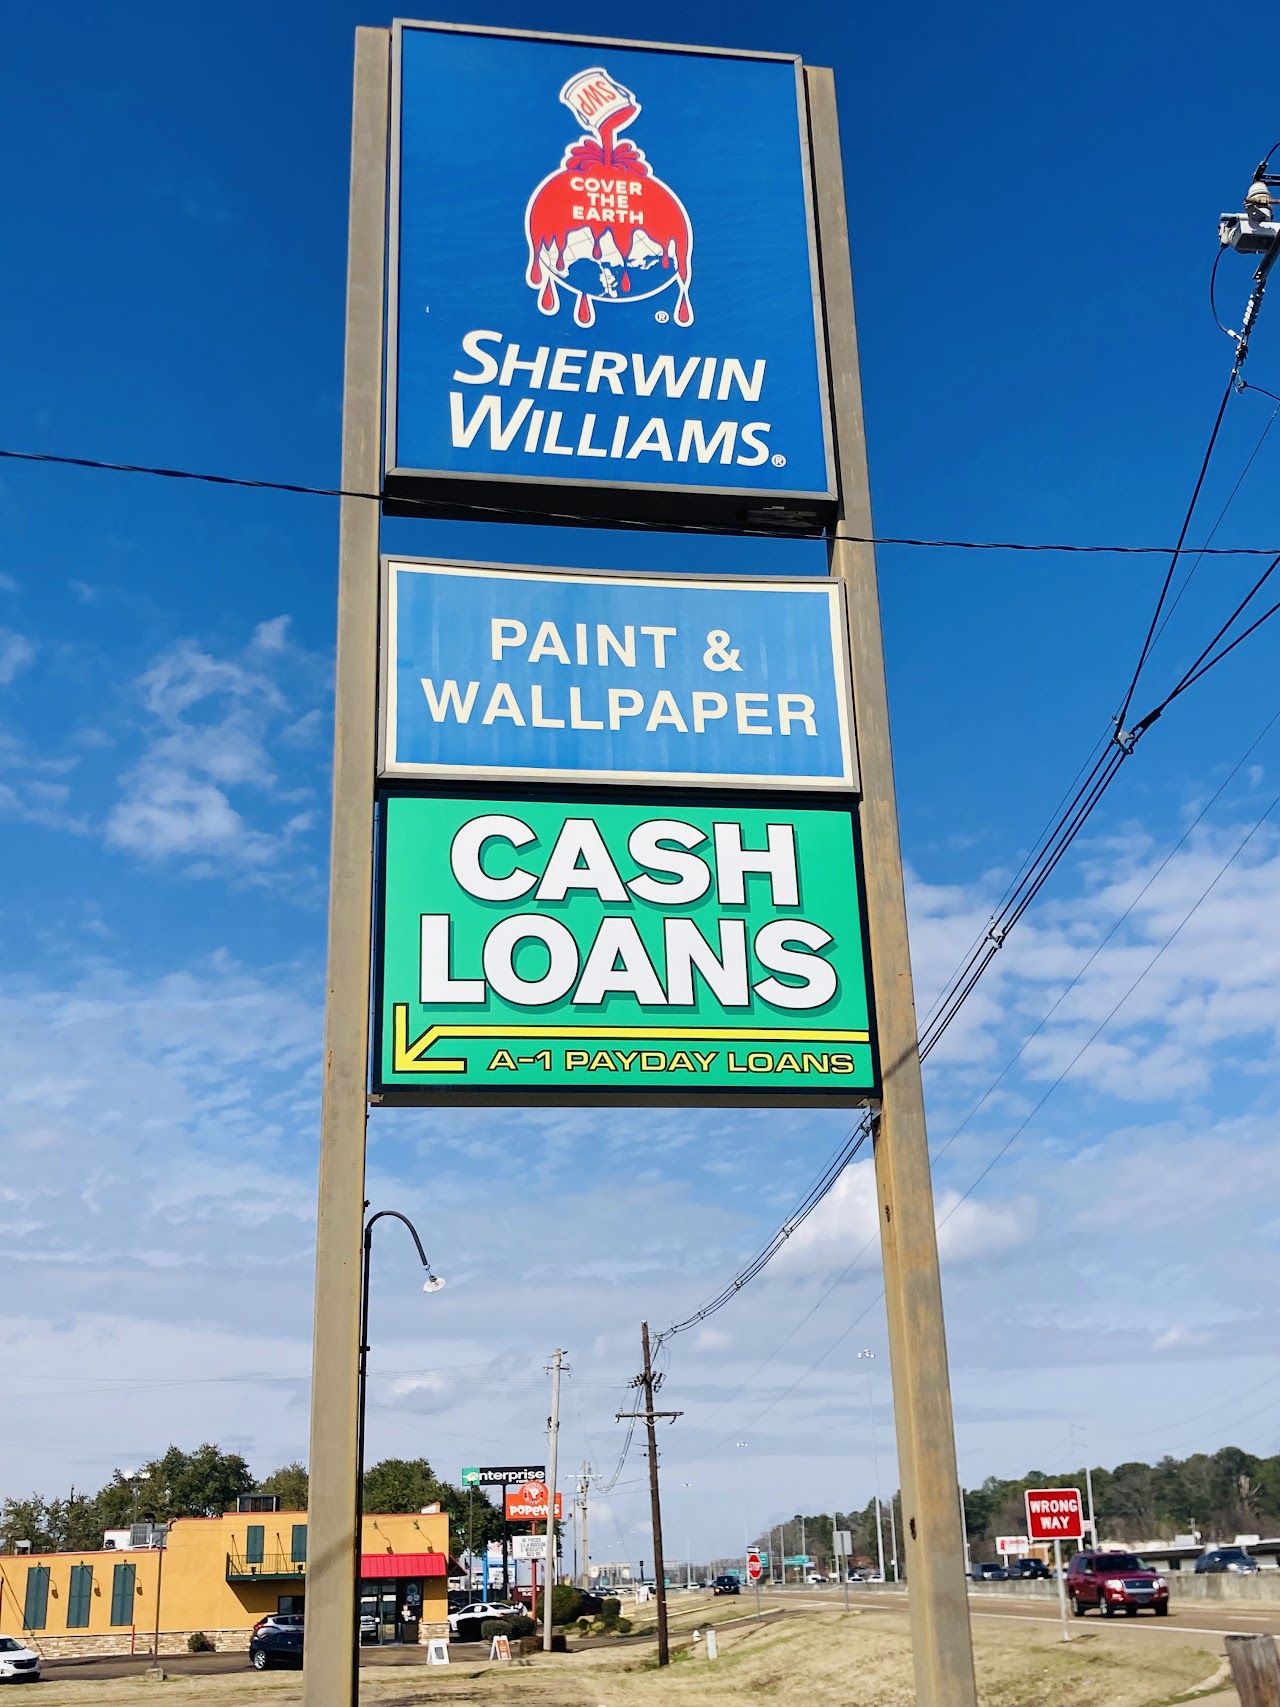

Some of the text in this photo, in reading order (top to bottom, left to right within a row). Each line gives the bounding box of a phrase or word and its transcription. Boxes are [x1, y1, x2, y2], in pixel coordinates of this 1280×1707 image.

[576, 80, 617, 116] SWP
[570, 176, 643, 196] COVER
[587, 192, 629, 209] THE
[572, 206, 644, 225] EARTH
[453, 329, 766, 401] SHERWIN
[449, 391, 771, 468] WILLIAMS
[491, 618, 744, 672] PAINT &
[420, 678, 819, 737] WALLPAPER
[450, 814, 800, 907] CASH
[419, 913, 838, 1010] LOANS
[486, 1049, 855, 1074] A-1 PAYDAY LOANS
[509, 1504, 560, 1516] POPEYS
[1029, 1499, 1078, 1513] WRONG
[1040, 1516, 1070, 1529] WAY
